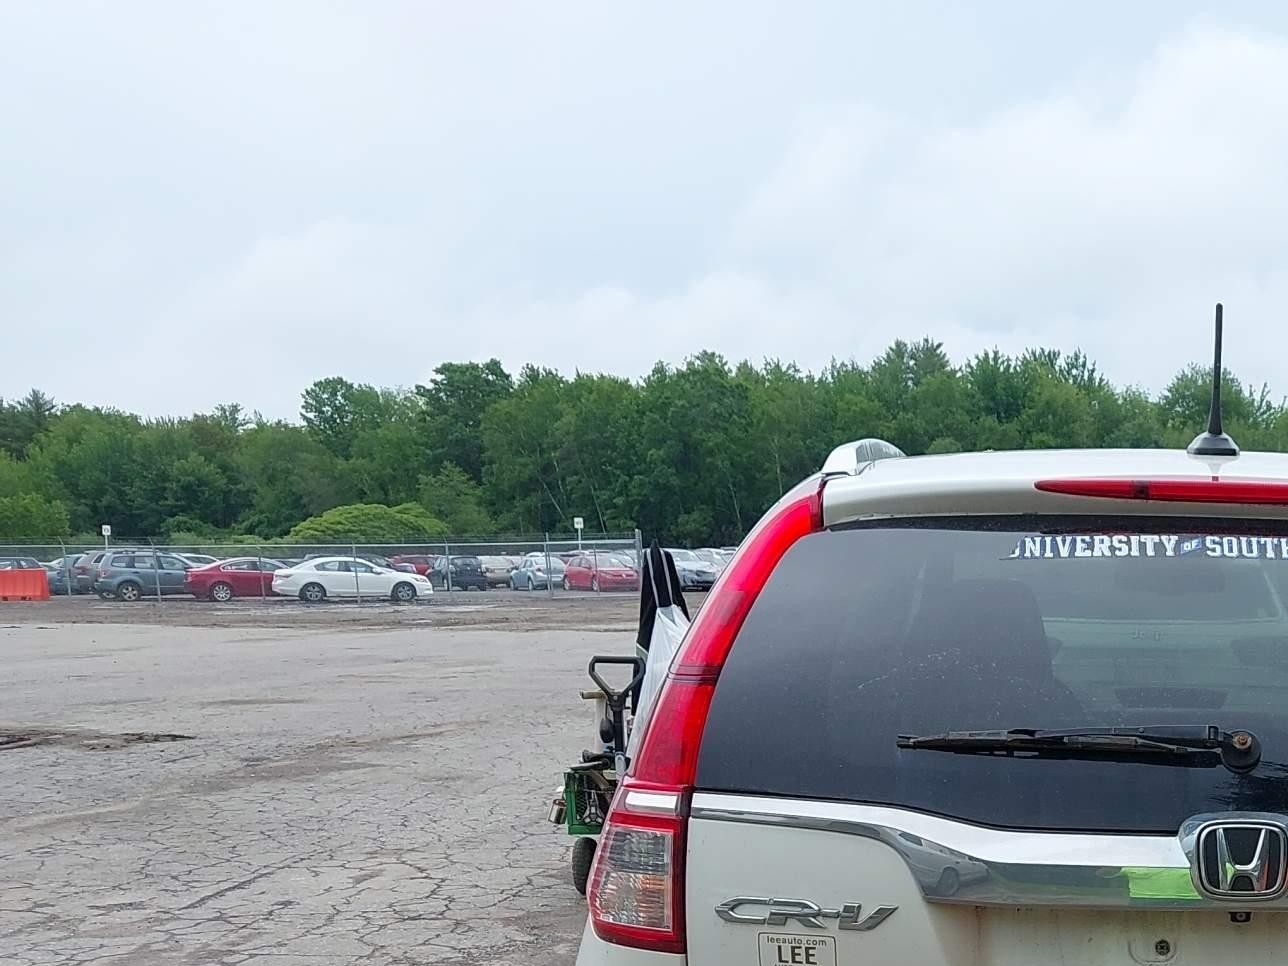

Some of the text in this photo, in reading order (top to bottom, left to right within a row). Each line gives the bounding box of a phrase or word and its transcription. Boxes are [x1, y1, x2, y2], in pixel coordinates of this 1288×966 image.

[714, 896, 899, 931] CR-V
[766, 935, 827, 947] leeauto.com
[777, 945, 818, 965] LEE
